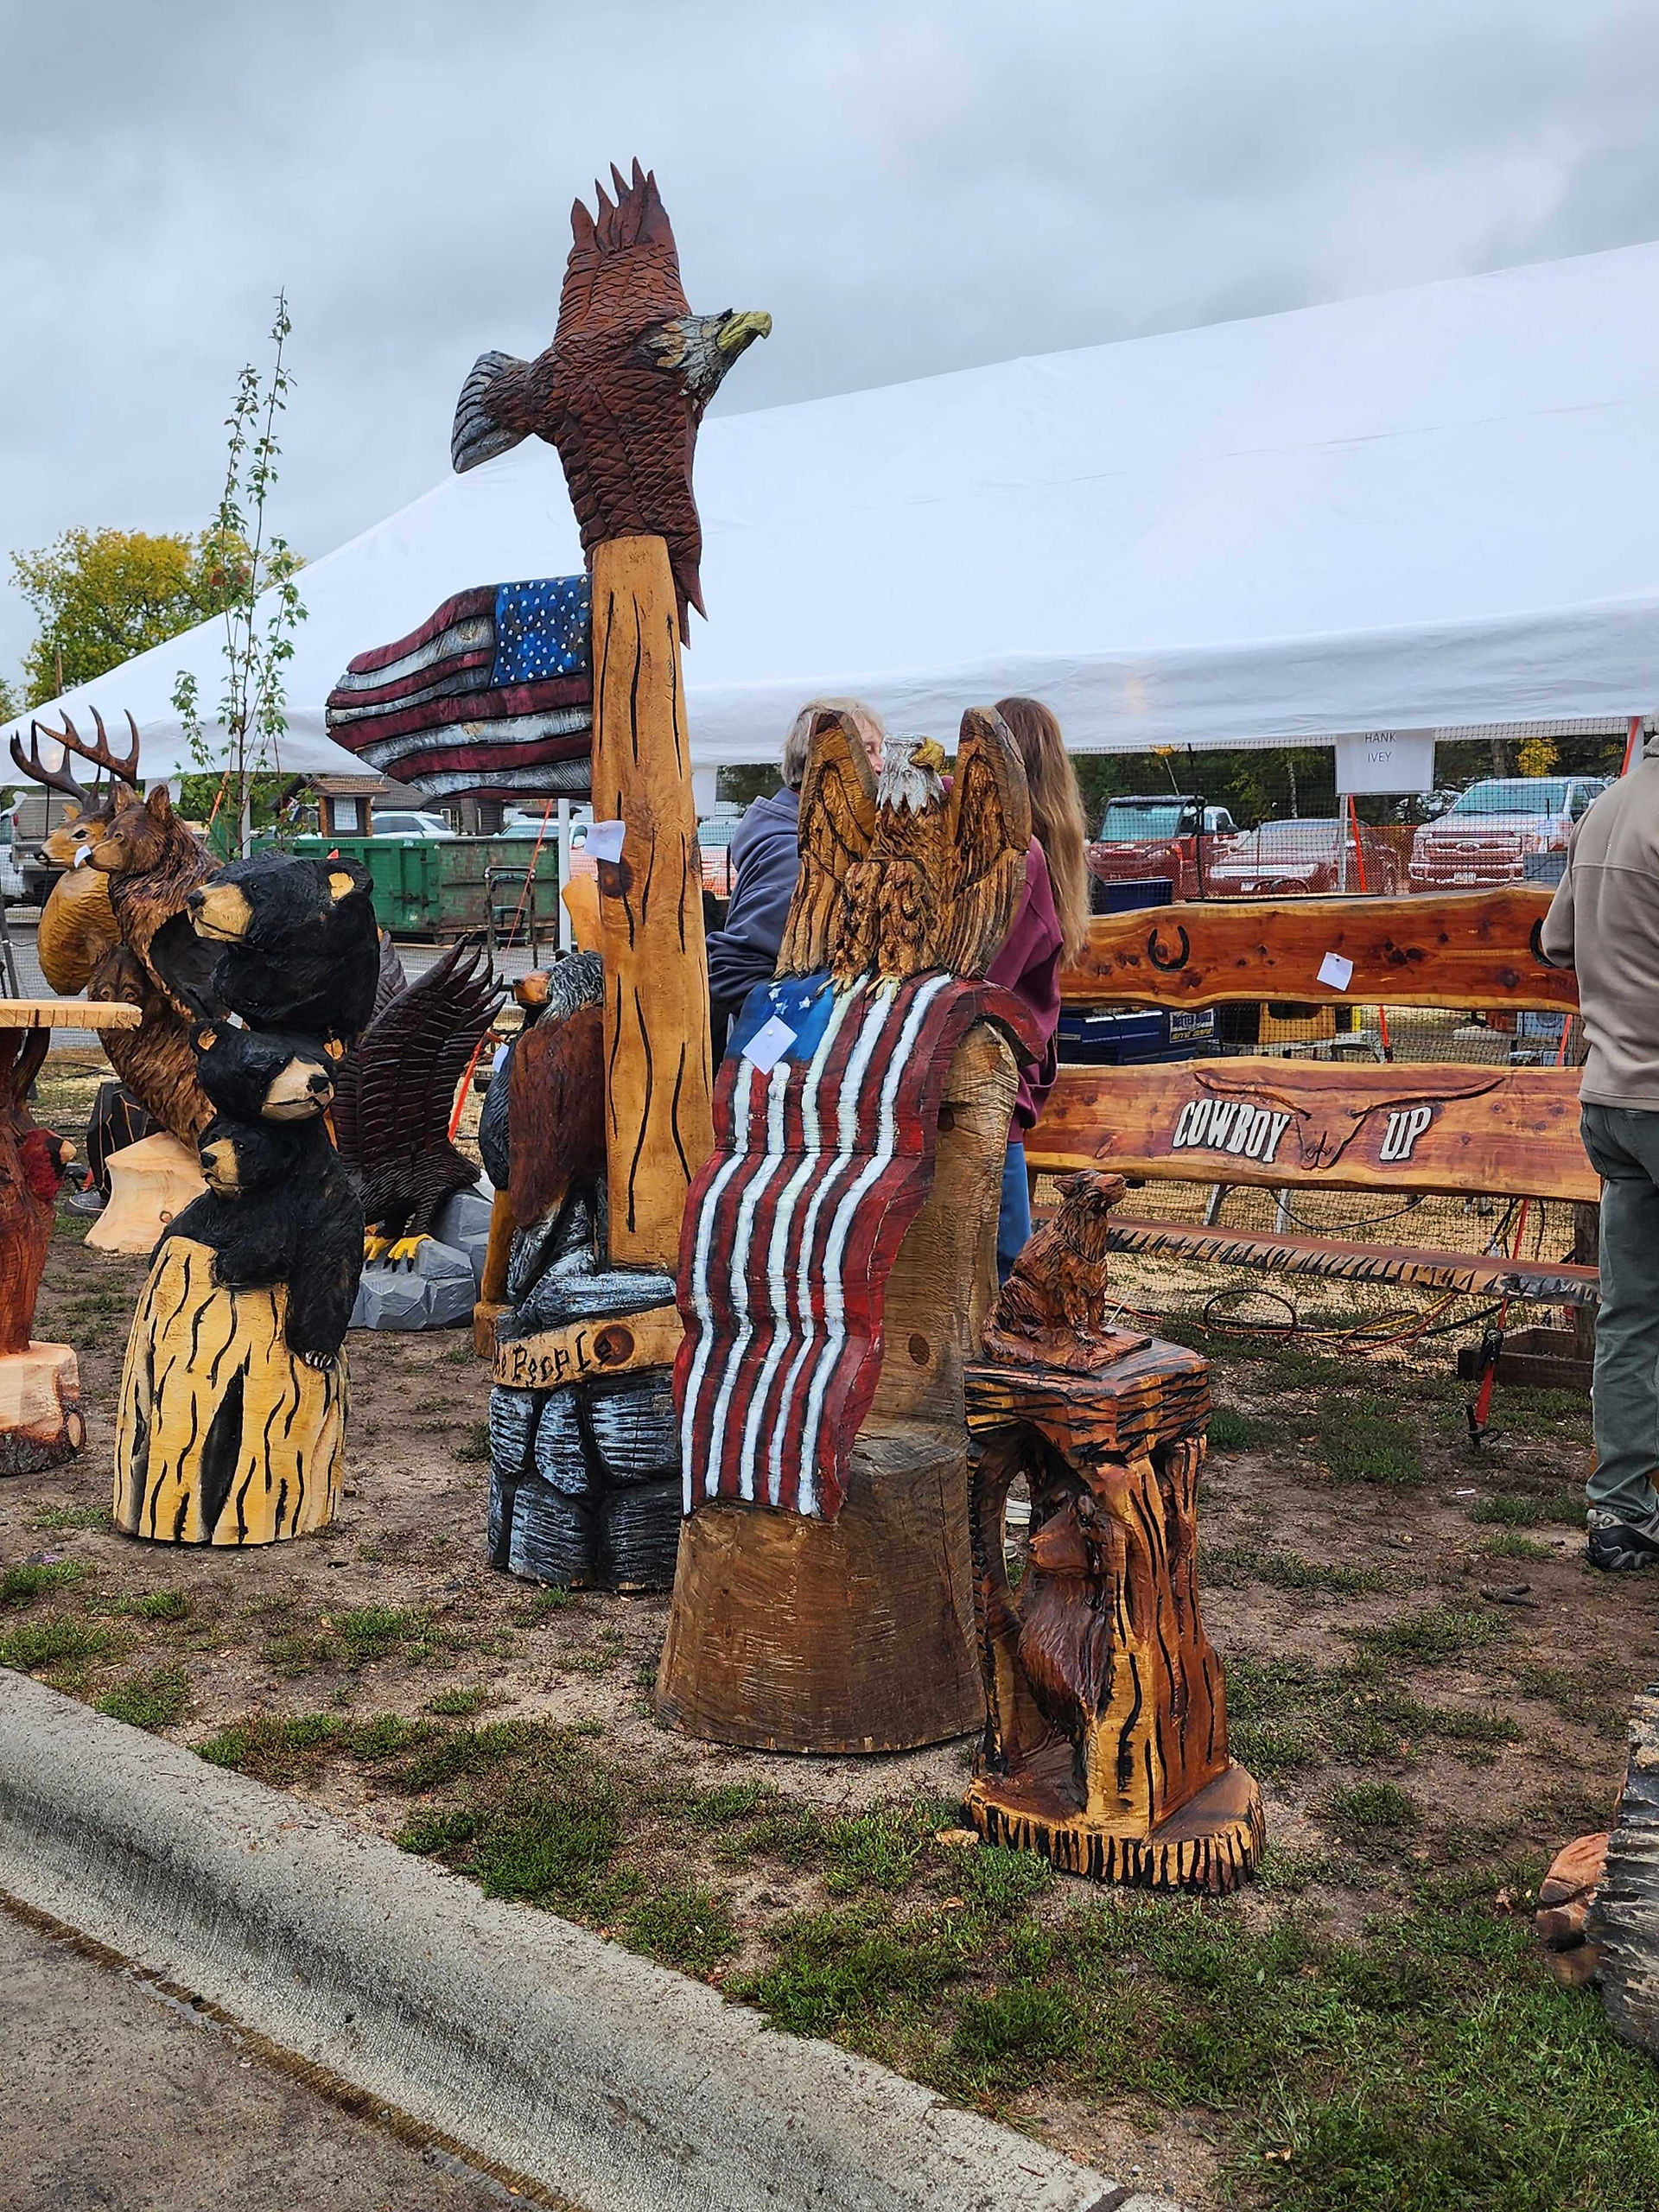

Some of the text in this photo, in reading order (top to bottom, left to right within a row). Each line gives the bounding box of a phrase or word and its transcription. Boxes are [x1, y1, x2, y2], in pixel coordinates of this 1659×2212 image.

[1364, 732, 1397, 743] HANK
[1368, 752, 1392, 763] IVEY
[1172, 1098, 1433, 1163] COWBOY UP
[493, 1343, 507, 1378] he
